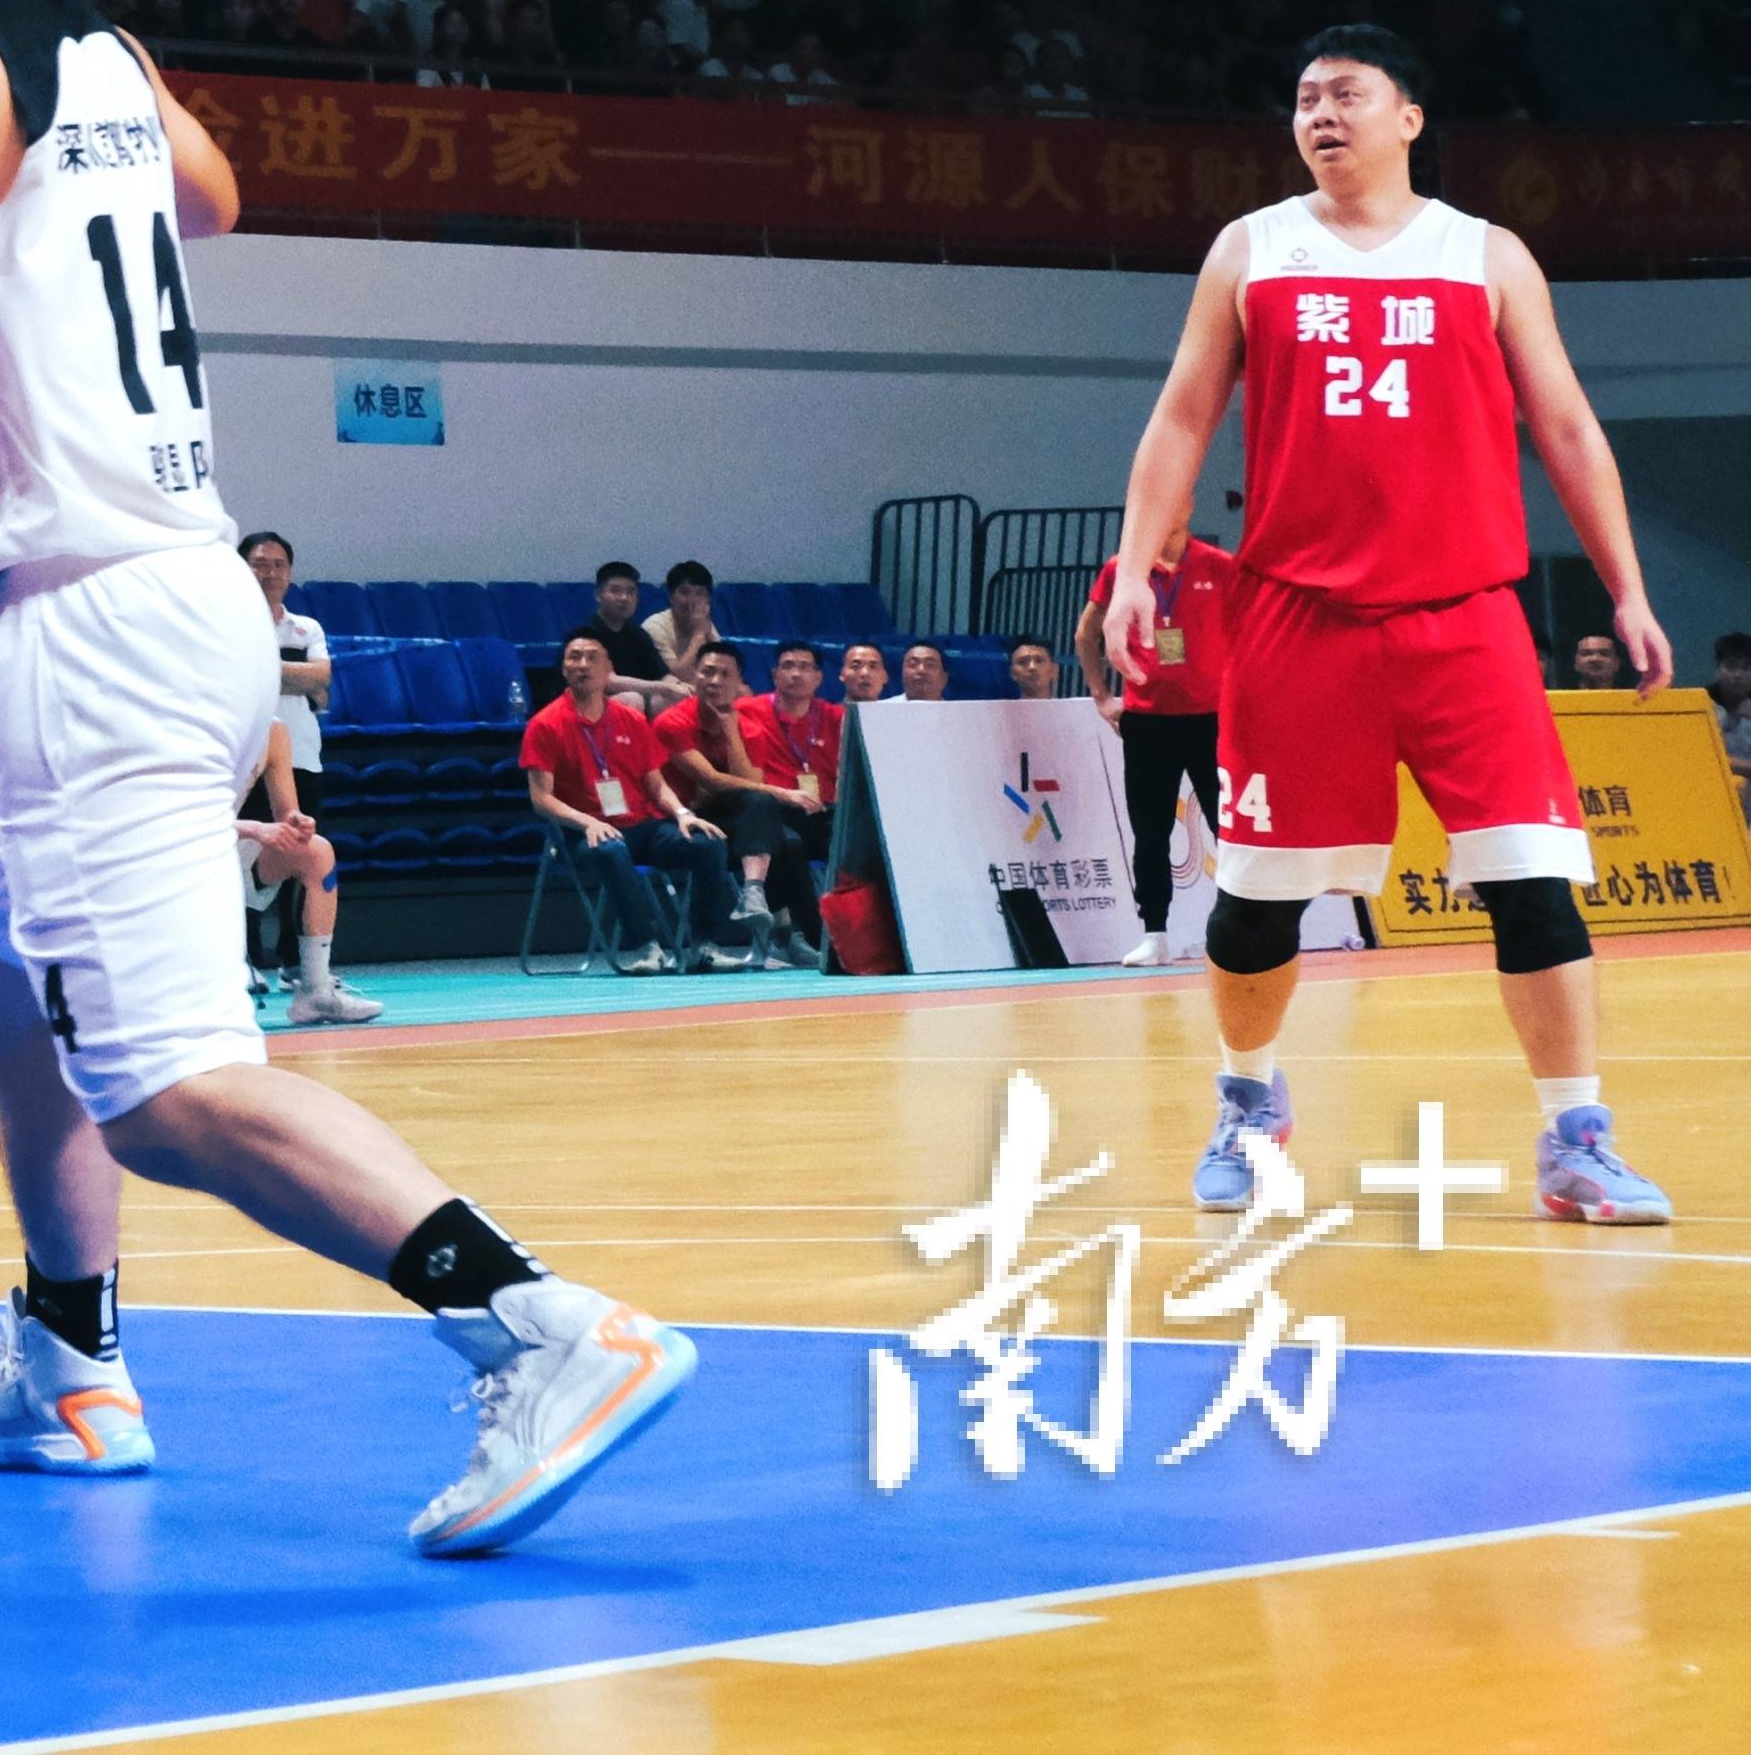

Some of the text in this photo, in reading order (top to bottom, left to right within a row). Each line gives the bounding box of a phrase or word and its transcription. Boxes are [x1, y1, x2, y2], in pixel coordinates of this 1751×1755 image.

[85, 211, 205, 415] 14
[1295, 293, 1435, 346] 紫城
[354, 383, 428, 420] 休息区
[1324, 355, 1411, 418] 24
[1216, 765, 1273, 833] 24
[988, 857, 1113, 891] 中国体育彩票
